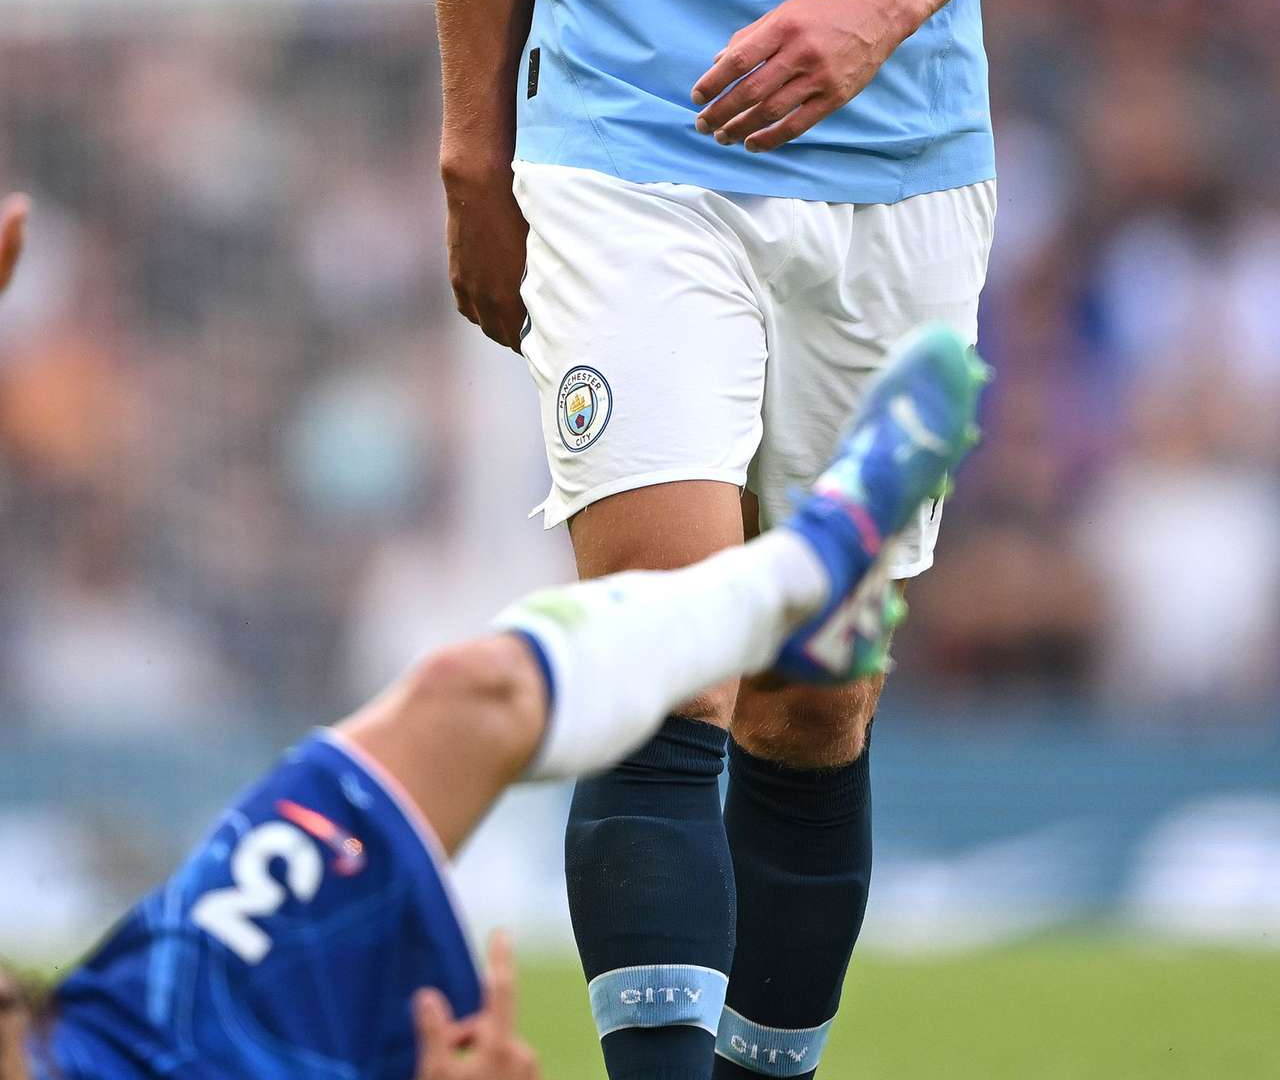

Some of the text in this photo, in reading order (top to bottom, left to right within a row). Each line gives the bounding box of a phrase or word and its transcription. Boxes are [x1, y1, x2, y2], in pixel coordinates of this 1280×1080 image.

[560, 373, 602, 408] MANCHESTER
[575, 432, 592, 447] CITY
[190, 820, 325, 967] 3
[621, 987, 703, 1005] CITY
[730, 1035, 809, 1064] CITY
